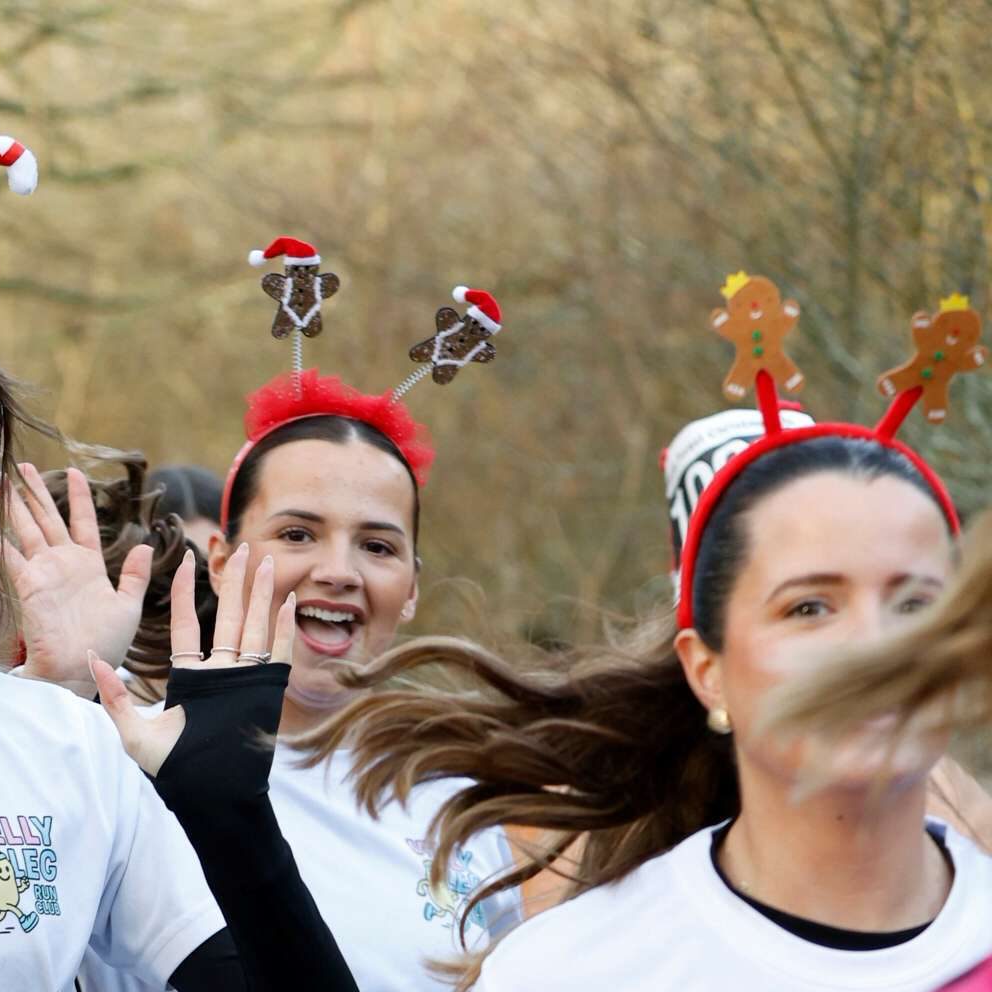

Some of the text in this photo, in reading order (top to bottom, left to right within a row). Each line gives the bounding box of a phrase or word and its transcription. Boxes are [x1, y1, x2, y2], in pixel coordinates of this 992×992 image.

[7, 848, 57, 881] LEG
[33, 884, 57, 900] RUN
[35, 901, 61, 916] CLUB
